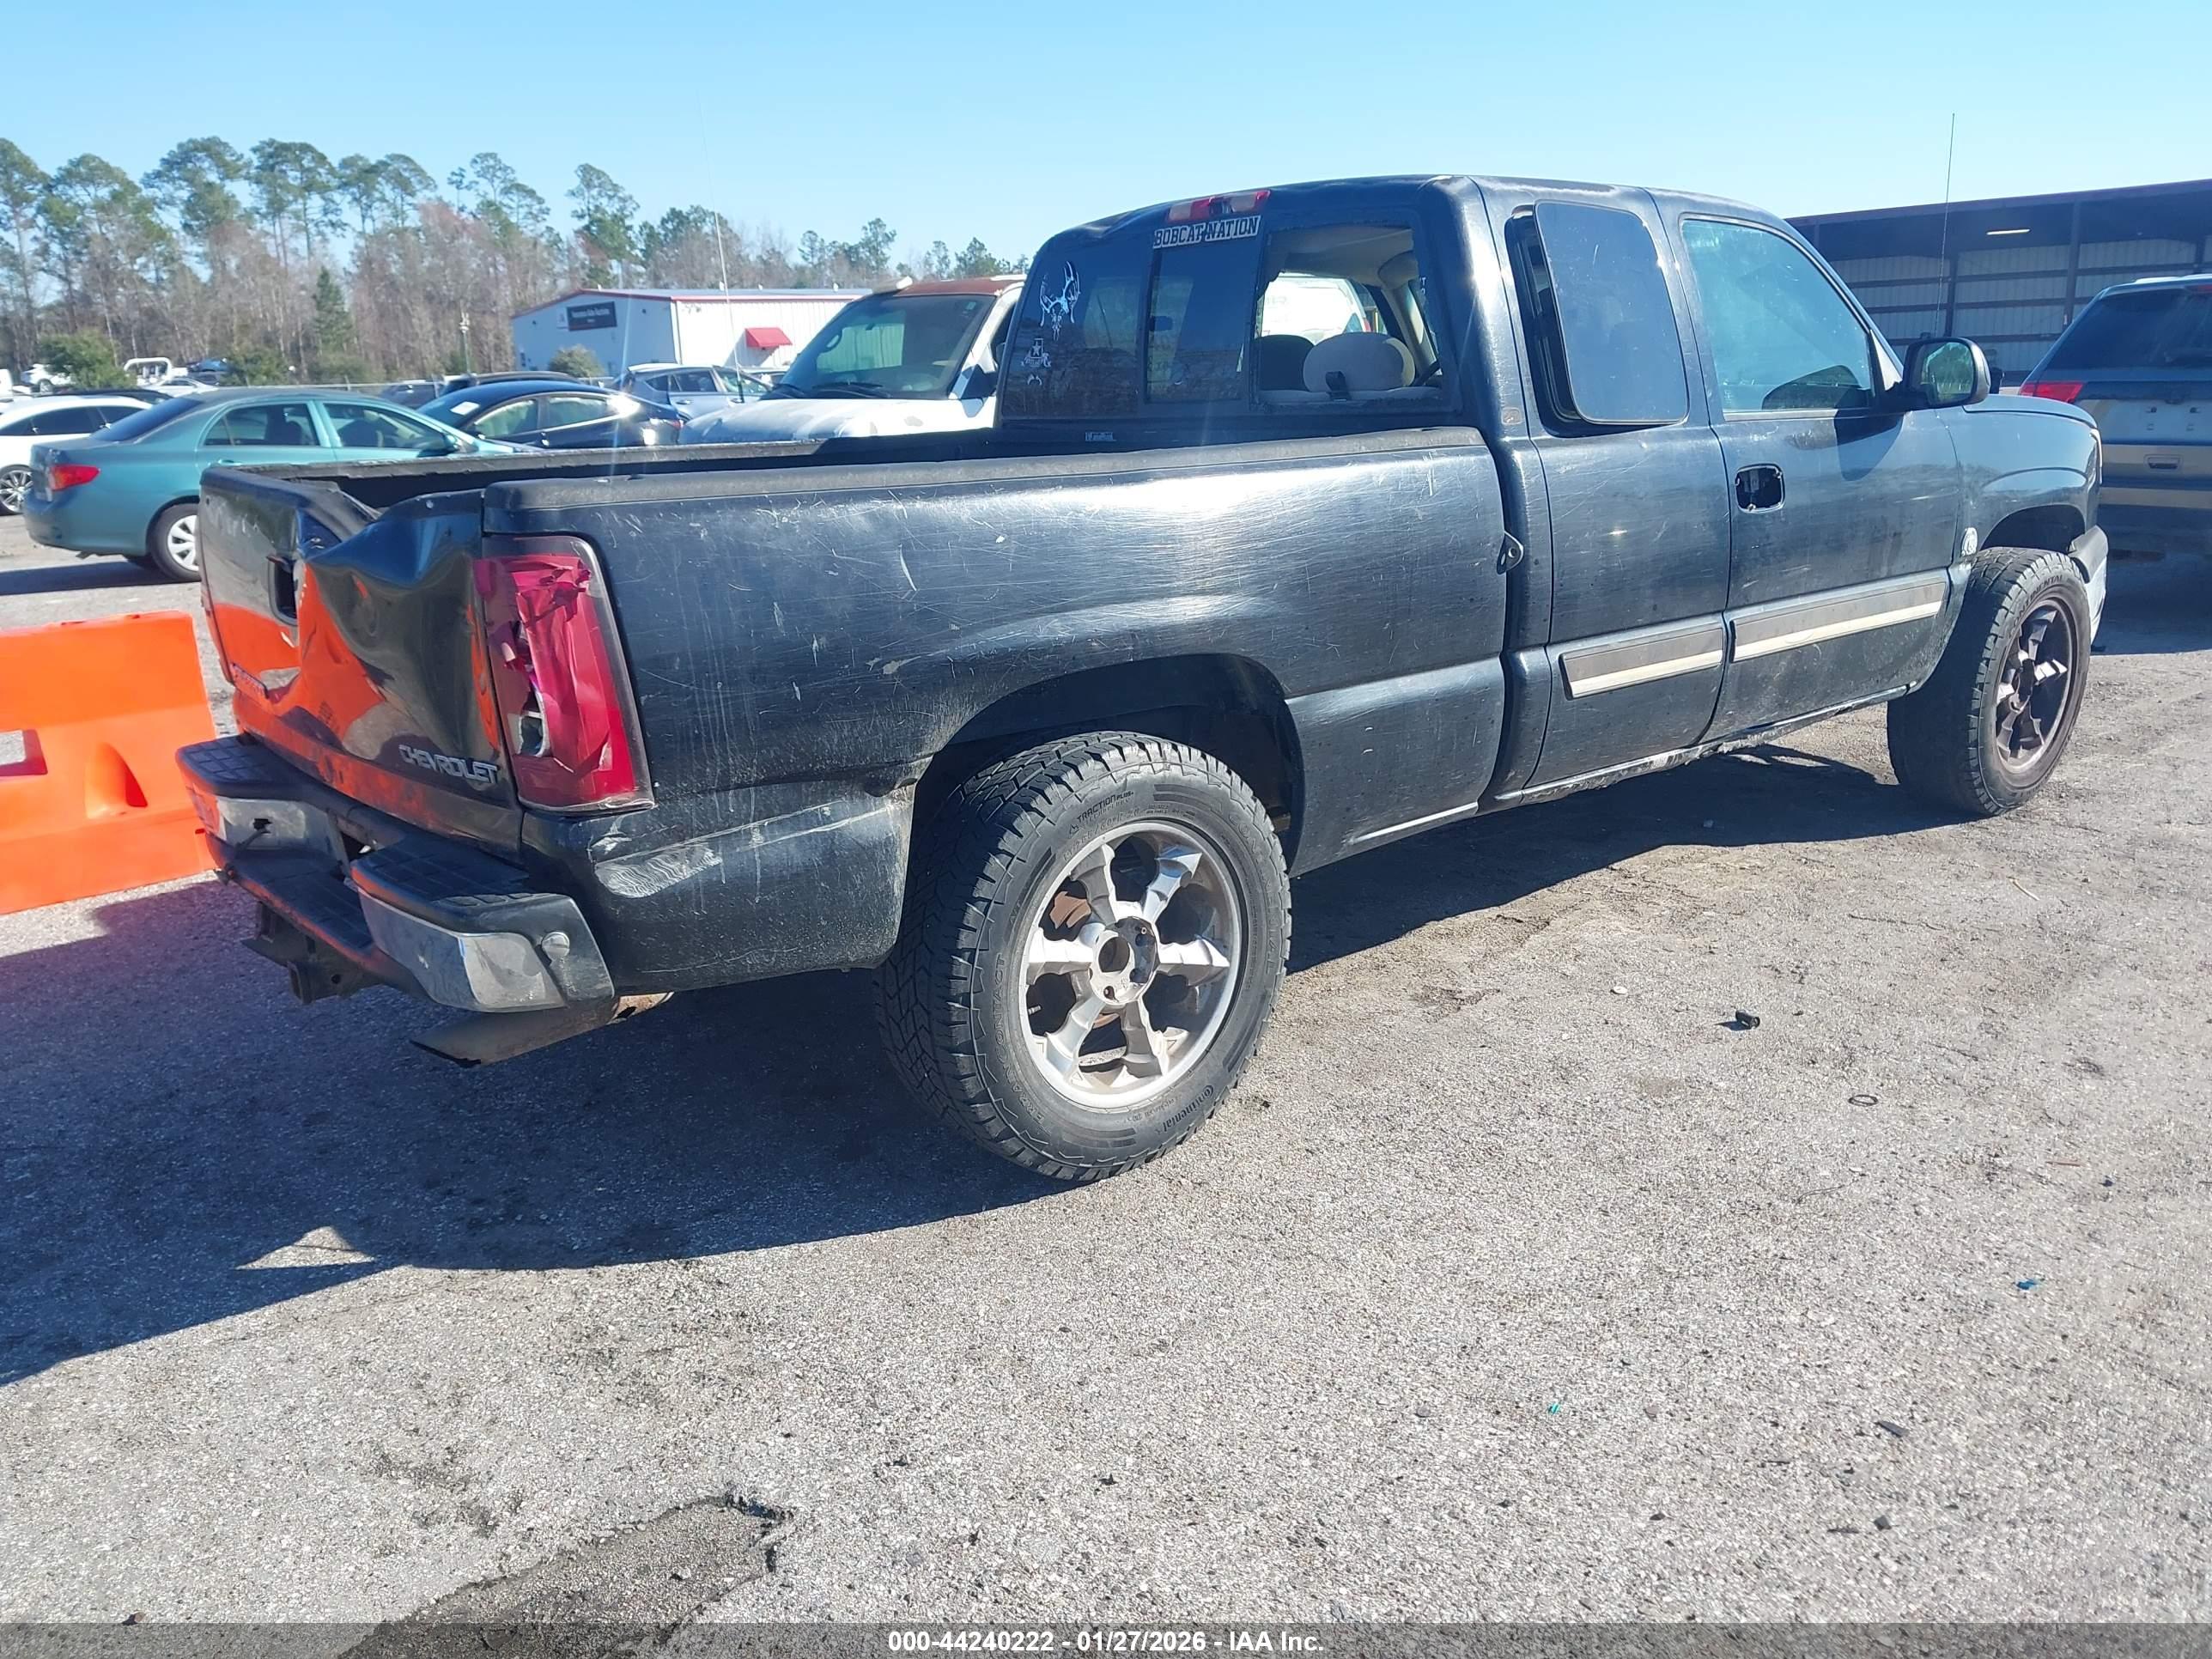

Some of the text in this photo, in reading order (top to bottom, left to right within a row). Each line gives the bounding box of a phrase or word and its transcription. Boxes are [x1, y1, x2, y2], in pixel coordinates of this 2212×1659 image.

[1153, 216, 1261, 248] BOBCAT NATION
[398, 744, 498, 784] CHEVROLET
[1163, 1085, 1214, 1132] Continental
